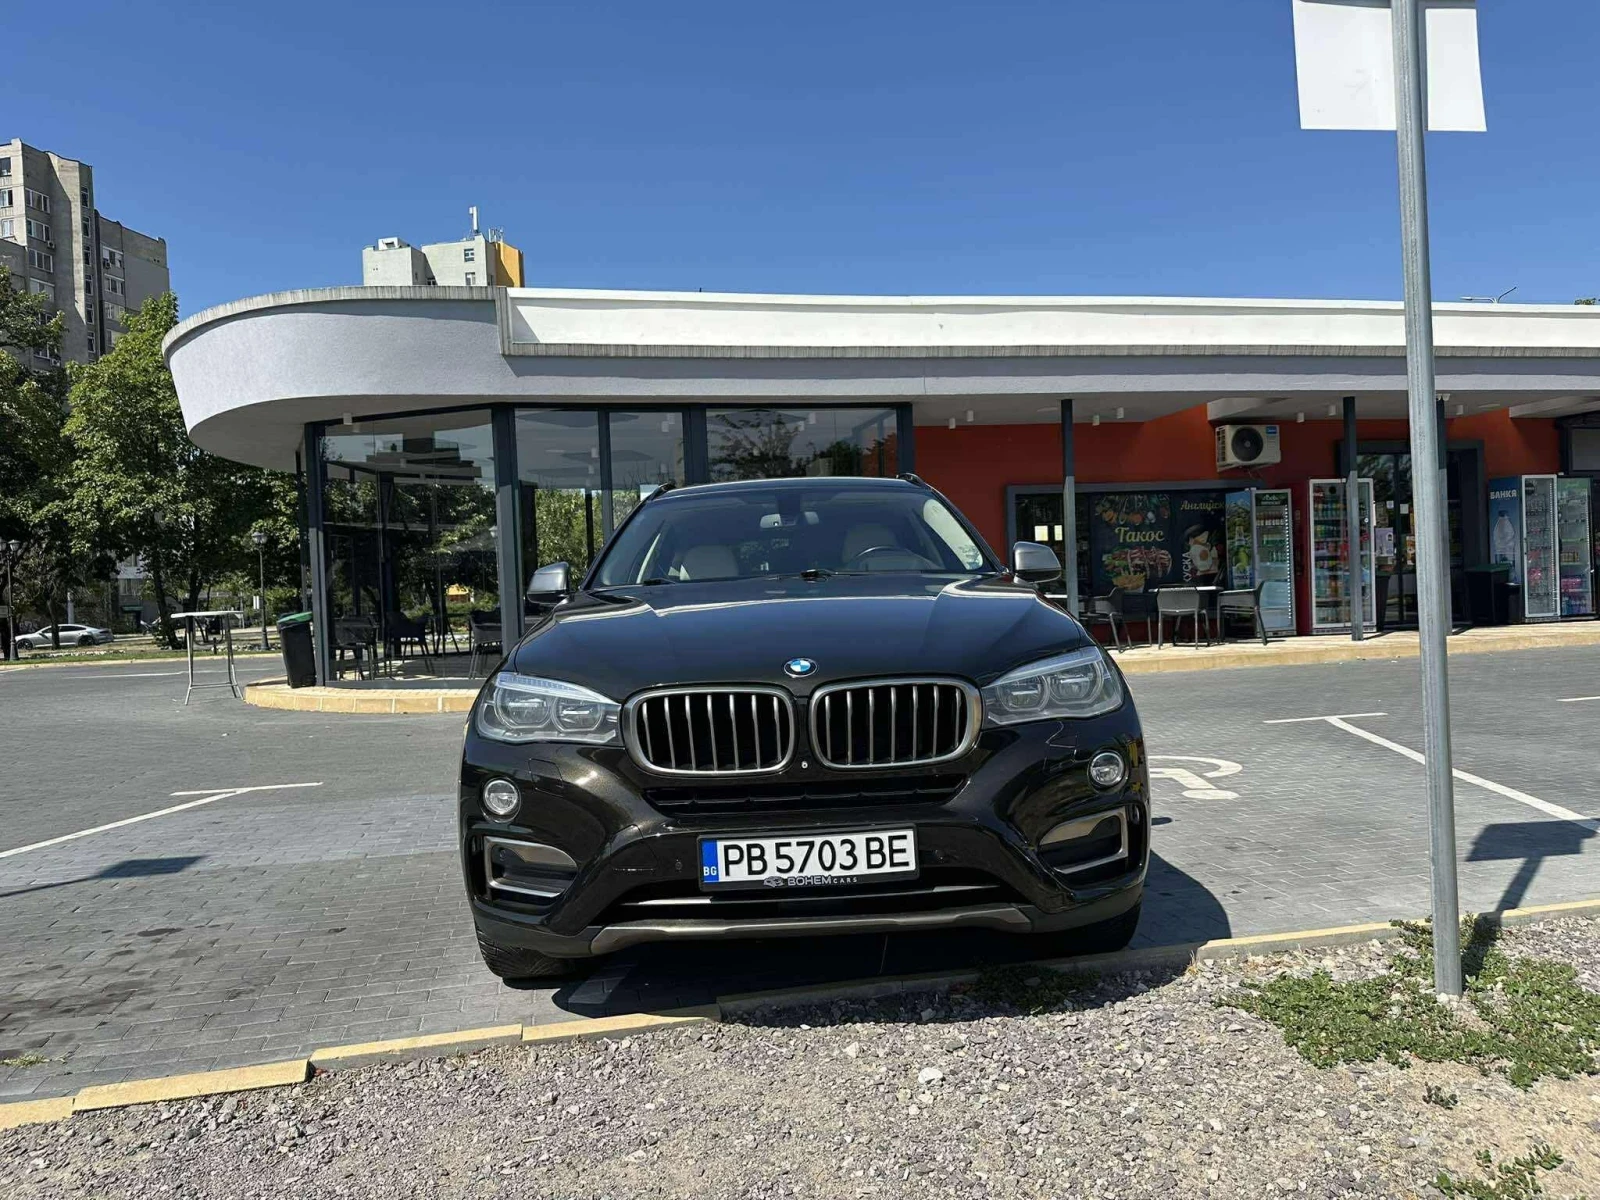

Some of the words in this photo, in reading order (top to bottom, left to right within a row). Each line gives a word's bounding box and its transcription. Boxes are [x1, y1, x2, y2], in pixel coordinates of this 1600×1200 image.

[1115, 526, 1166, 543] Такос
[774, 838, 858, 874] 5703
[703, 866, 717, 877] BG
[787, 875, 832, 887] BOHEM
